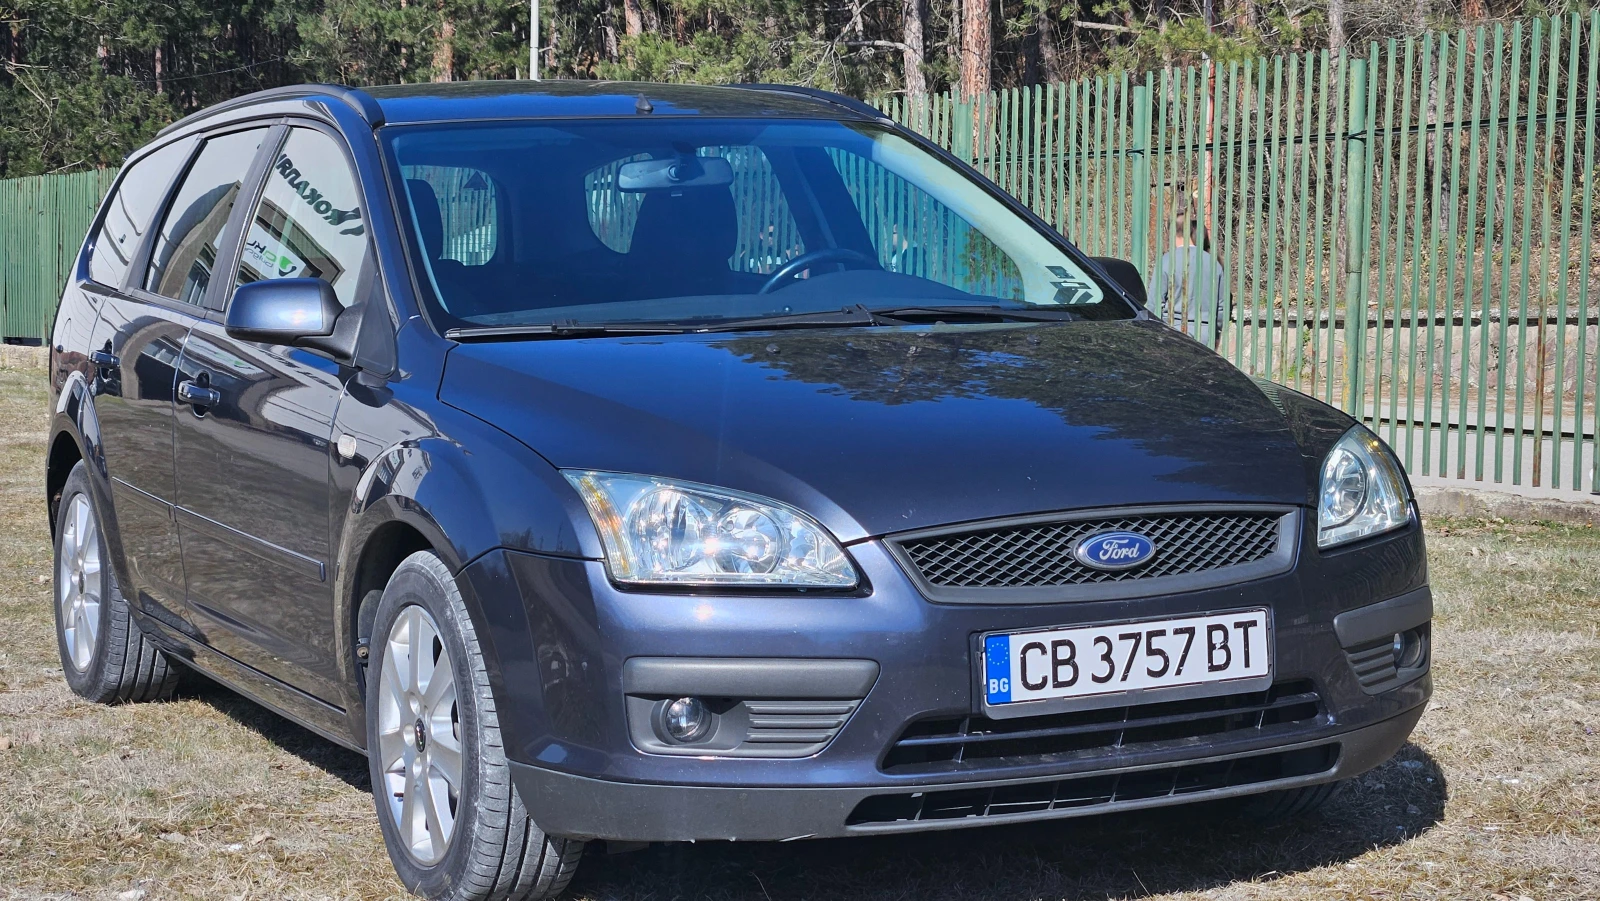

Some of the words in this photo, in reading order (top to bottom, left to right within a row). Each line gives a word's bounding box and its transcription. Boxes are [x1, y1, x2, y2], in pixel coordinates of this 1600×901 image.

[1099, 539, 1140, 561] Ford
[1019, 639, 1079, 691] CB
[1091, 626, 1196, 684] 3757
[1206, 619, 1258, 673] BT
[989, 678, 1009, 694] BG
